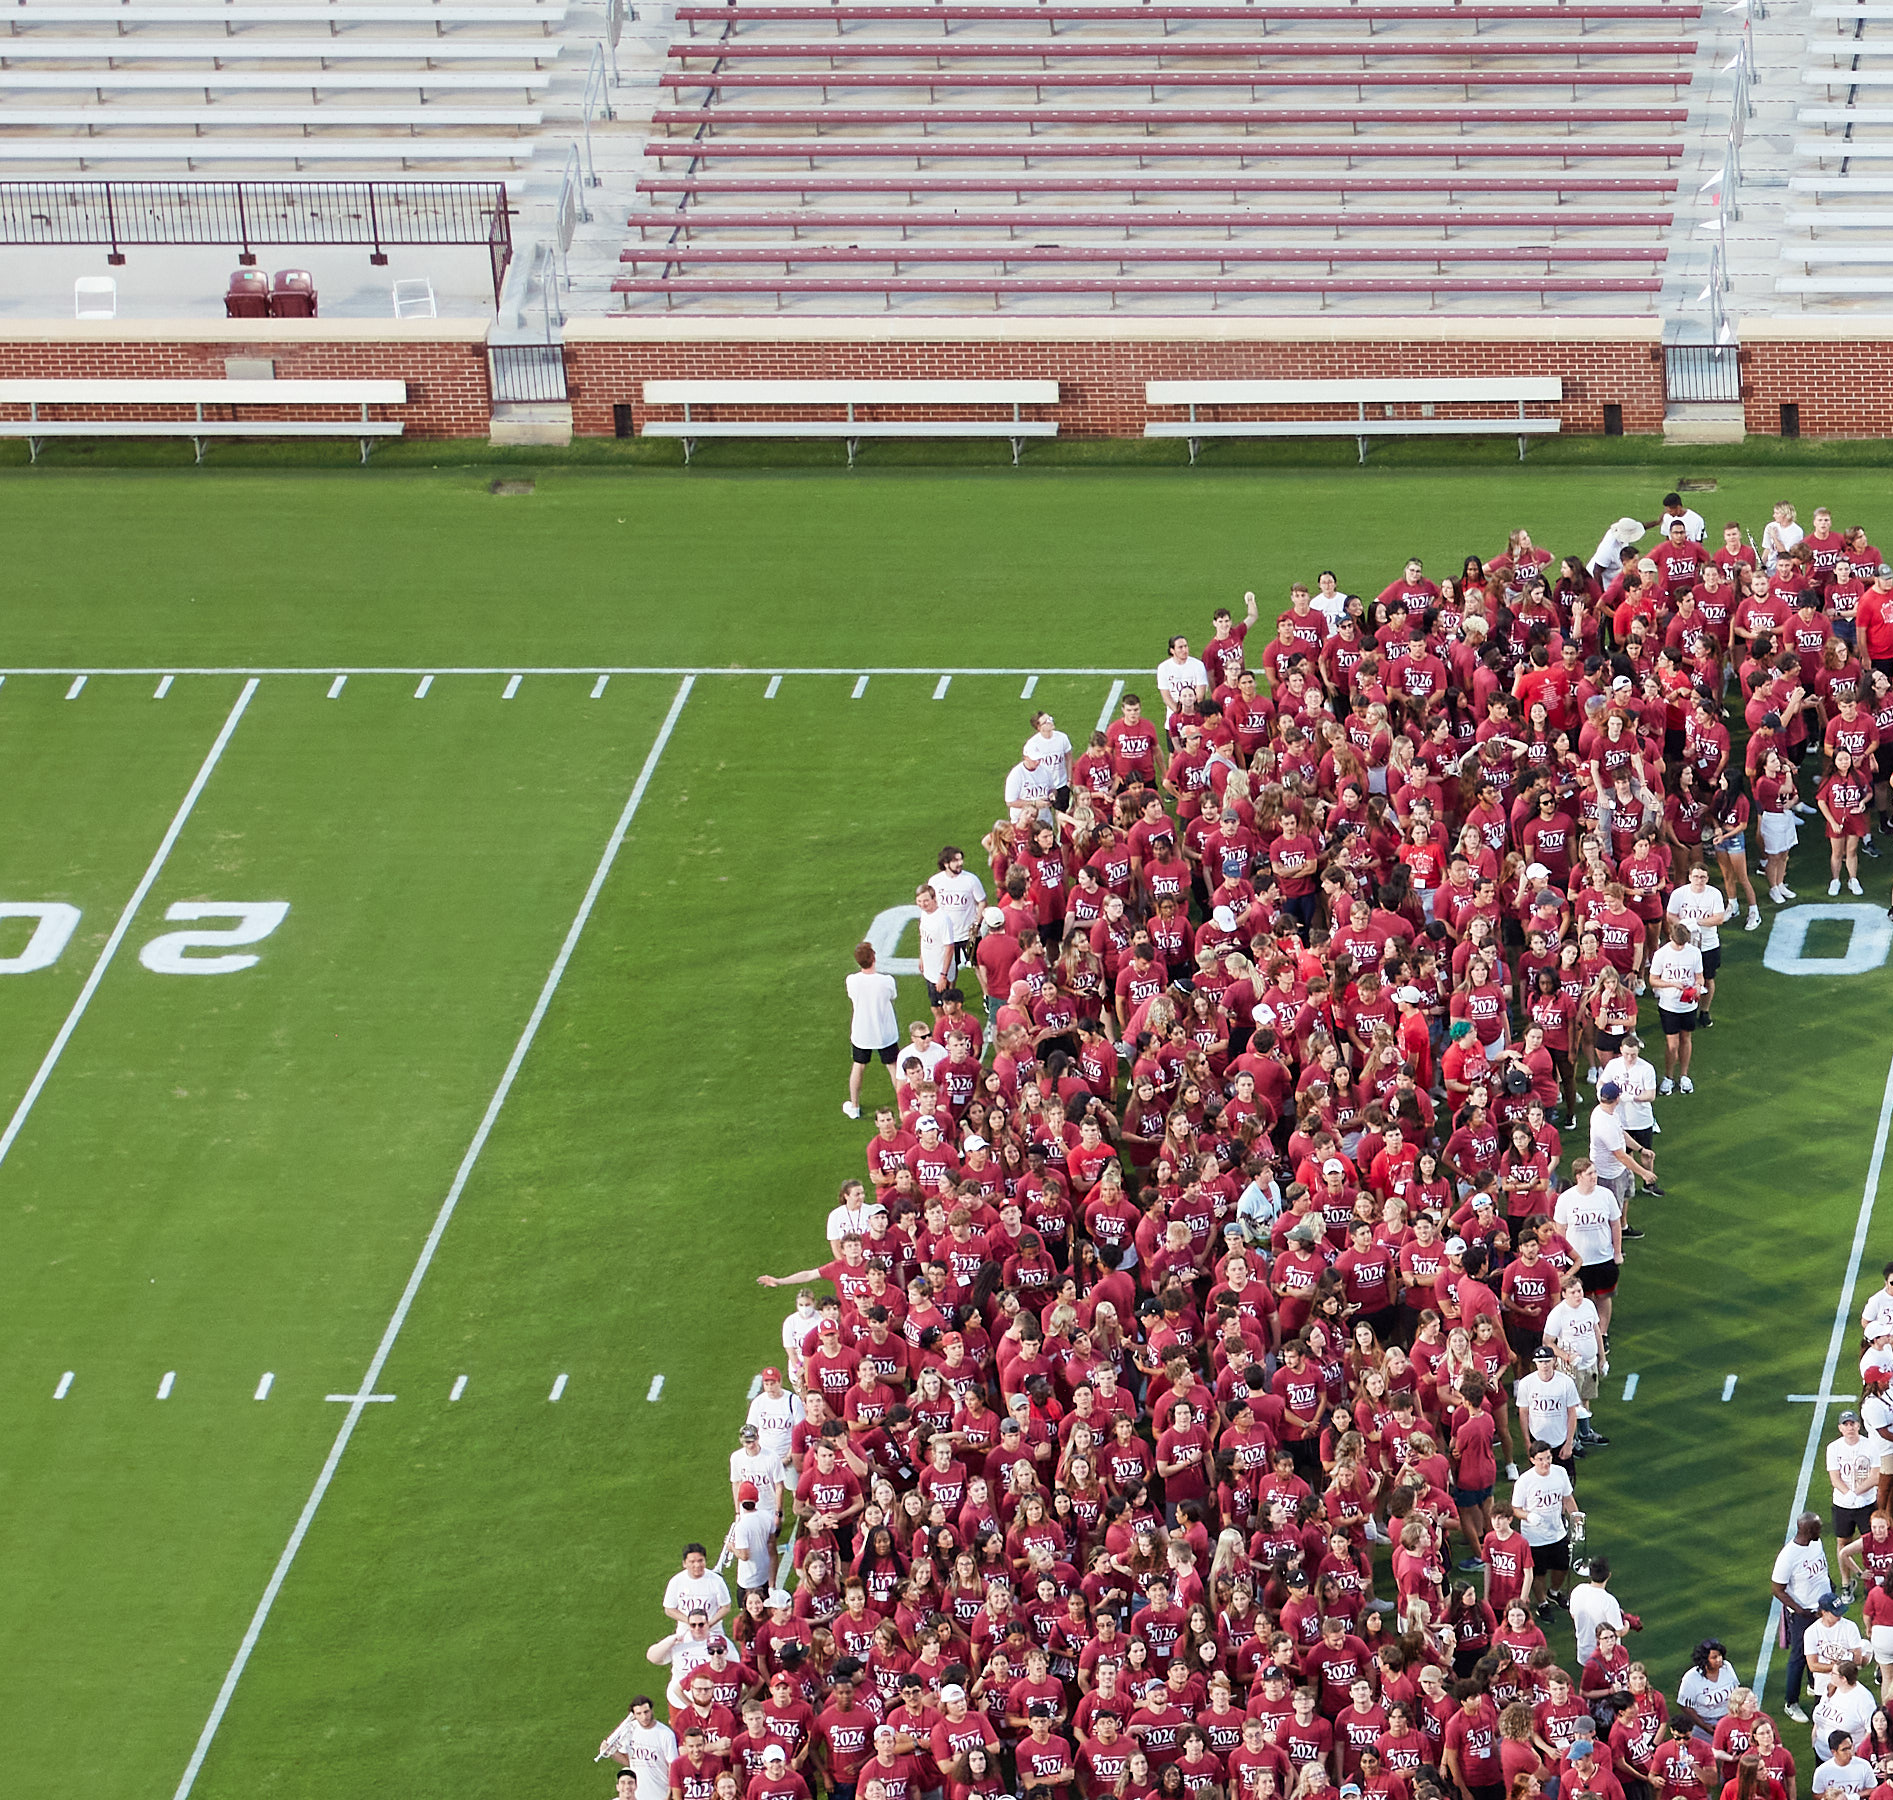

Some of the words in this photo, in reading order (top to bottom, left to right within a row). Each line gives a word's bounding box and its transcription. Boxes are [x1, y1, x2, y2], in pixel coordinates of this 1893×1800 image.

[1798, 634, 1822, 646] 2026
[940, 894, 967, 905] 2026
[1472, 1000, 1498, 1013] 2026
[1325, 1210, 1353, 1222] 2026
[1576, 1213, 1604, 1225] 2026
[1515, 1281, 1545, 1295] 2026
[1534, 1399, 1563, 1411] 2026
[762, 1418, 792, 1429] 2026
[816, 1490, 844, 1502] 2026
[680, 1599, 710, 1610] 2026
[833, 1732, 865, 1746] 2026
